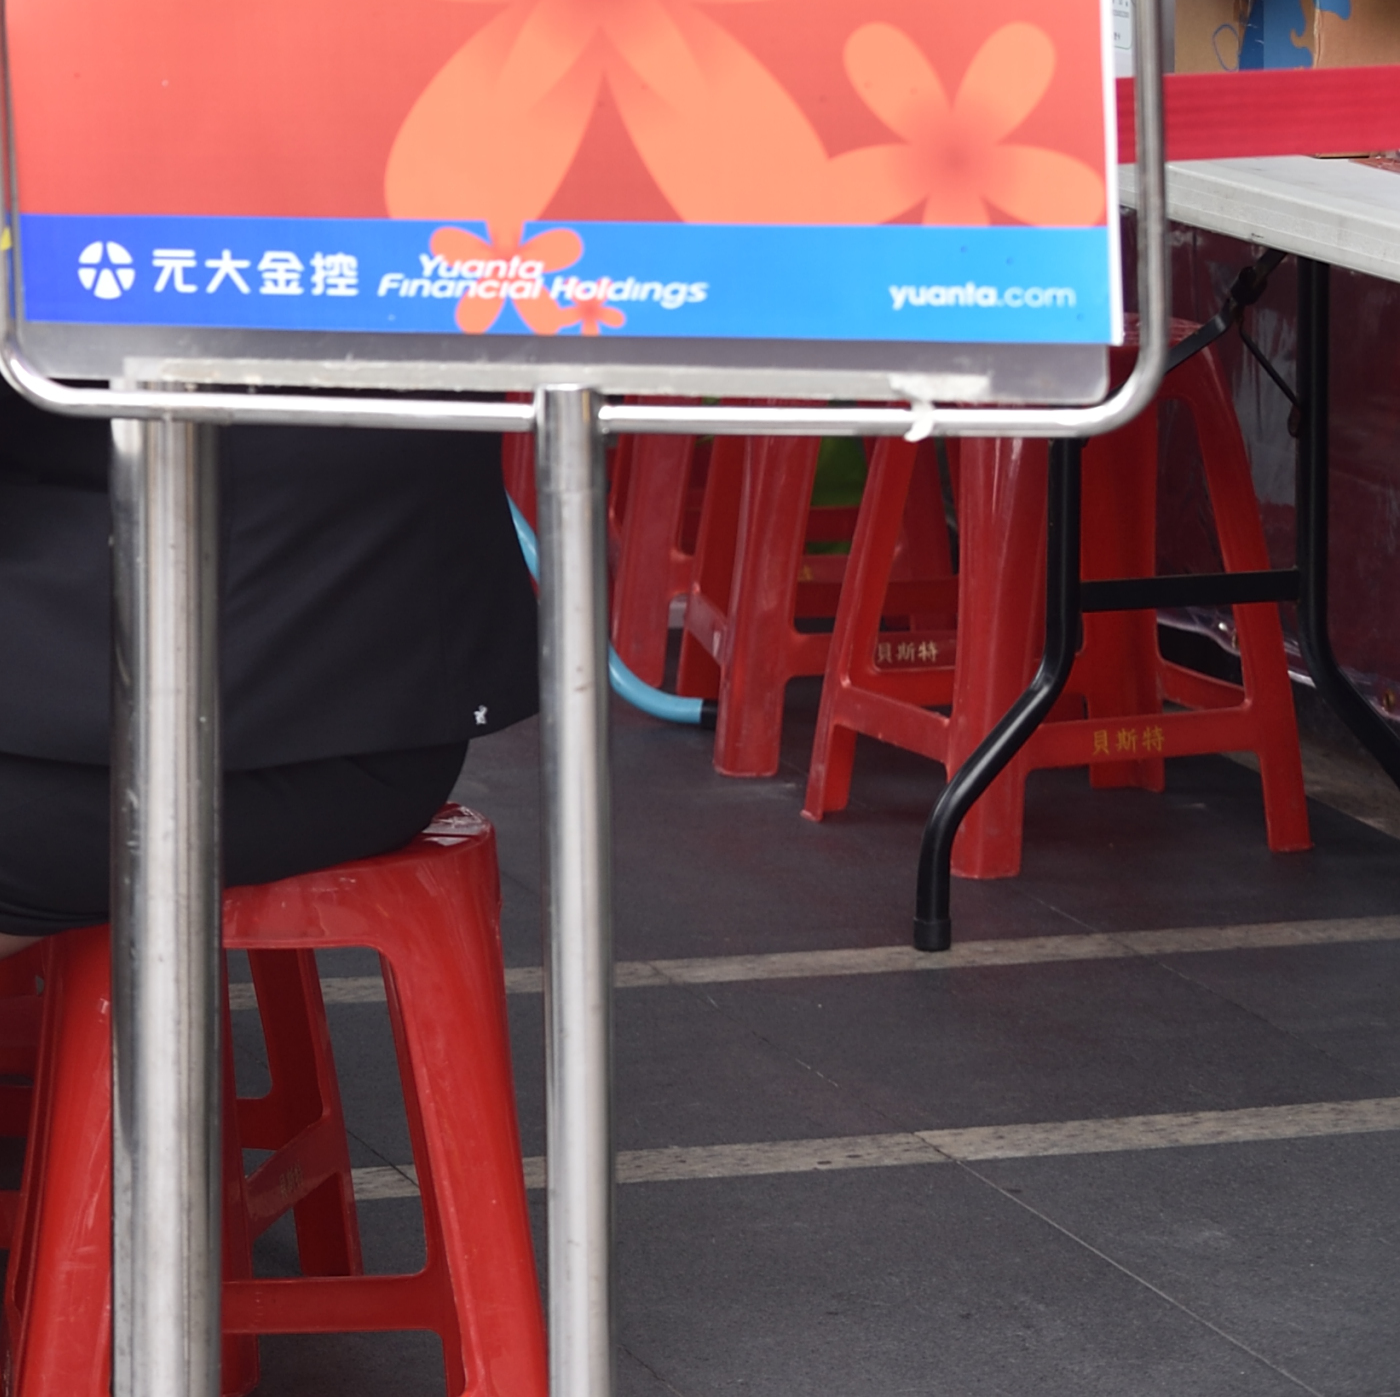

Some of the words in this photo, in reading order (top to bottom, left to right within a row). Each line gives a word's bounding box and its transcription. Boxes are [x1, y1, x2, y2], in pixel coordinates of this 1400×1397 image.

[152, 248, 360, 297] 元大金控
[418, 253, 545, 280] Yuanta
[377, 273, 544, 300] Financial
[550, 275, 710, 310] Holdings
[888, 280, 1077, 311] yuanta.com
[1092, 725, 1165, 756] 貝斯特
